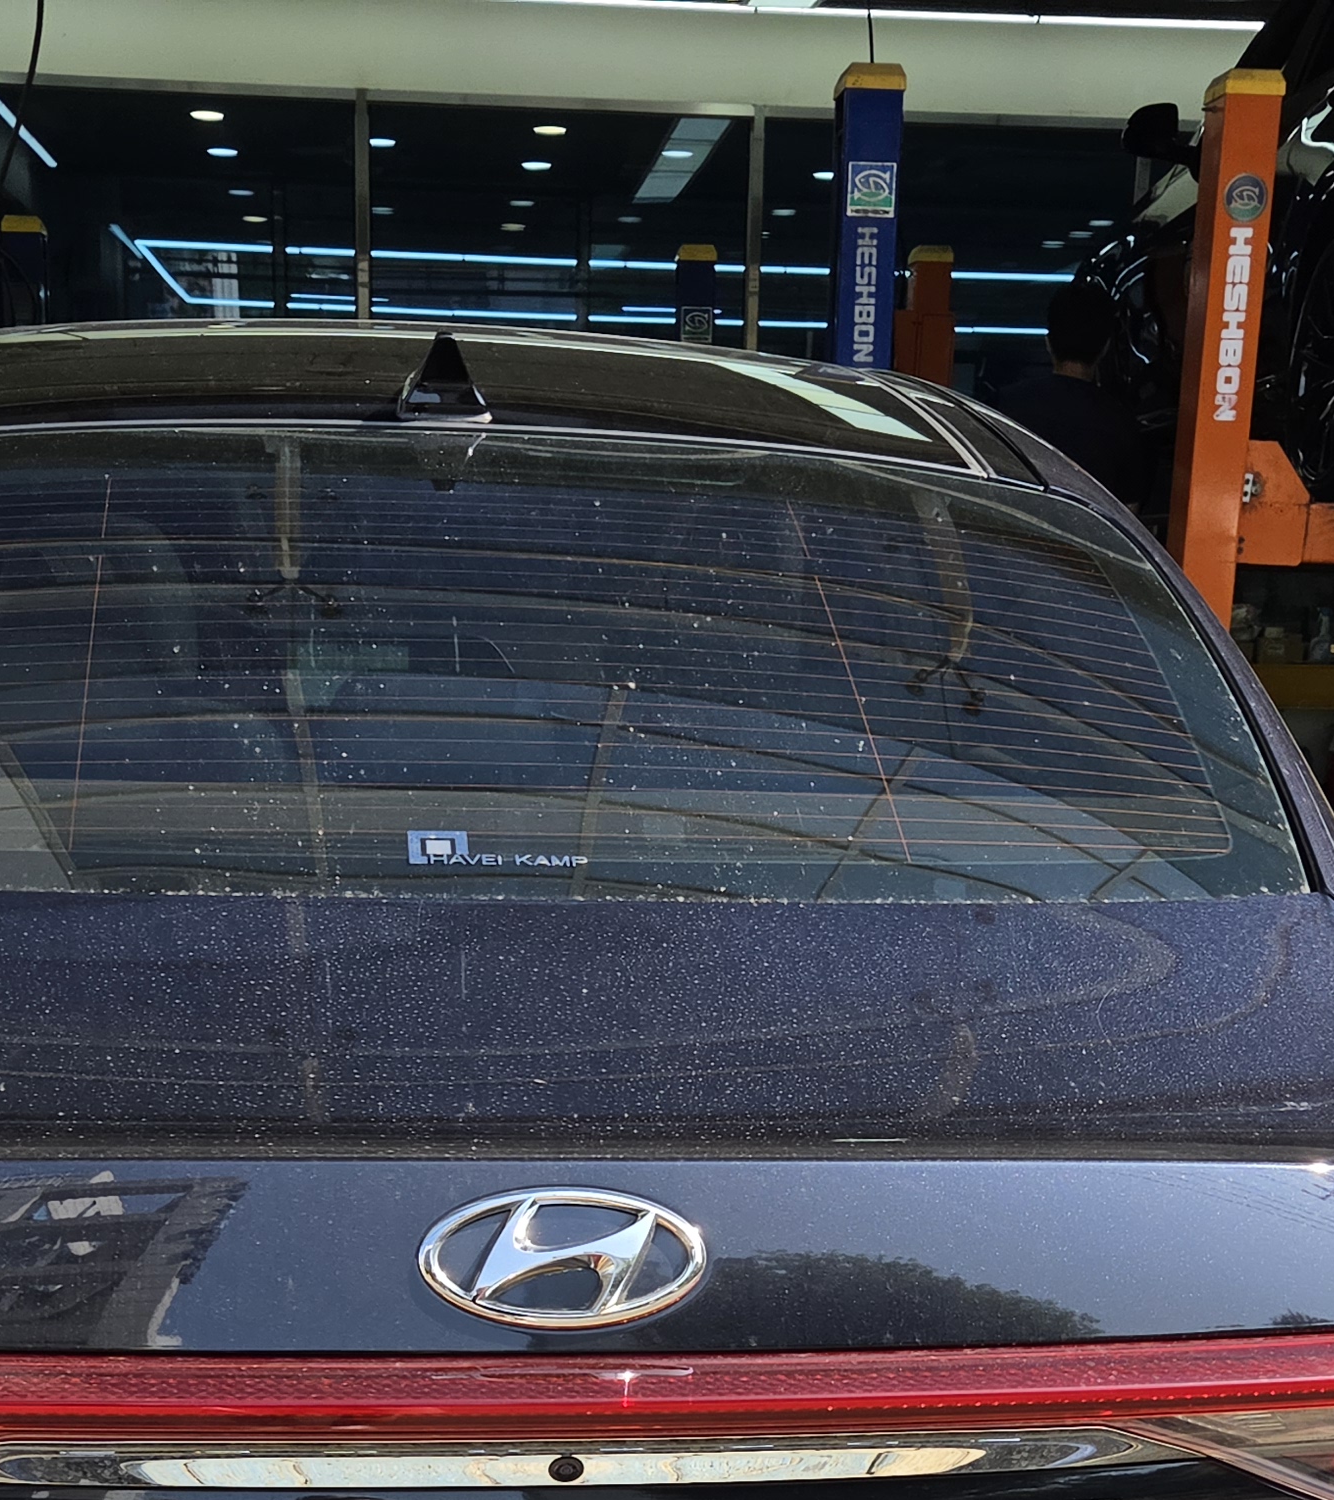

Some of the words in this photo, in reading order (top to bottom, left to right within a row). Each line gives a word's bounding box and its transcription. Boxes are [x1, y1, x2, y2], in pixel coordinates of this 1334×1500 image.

[852, 226, 879, 364] HESHBON
[1212, 226, 1255, 422] HESHBON
[514, 854, 589, 868] KAMP
